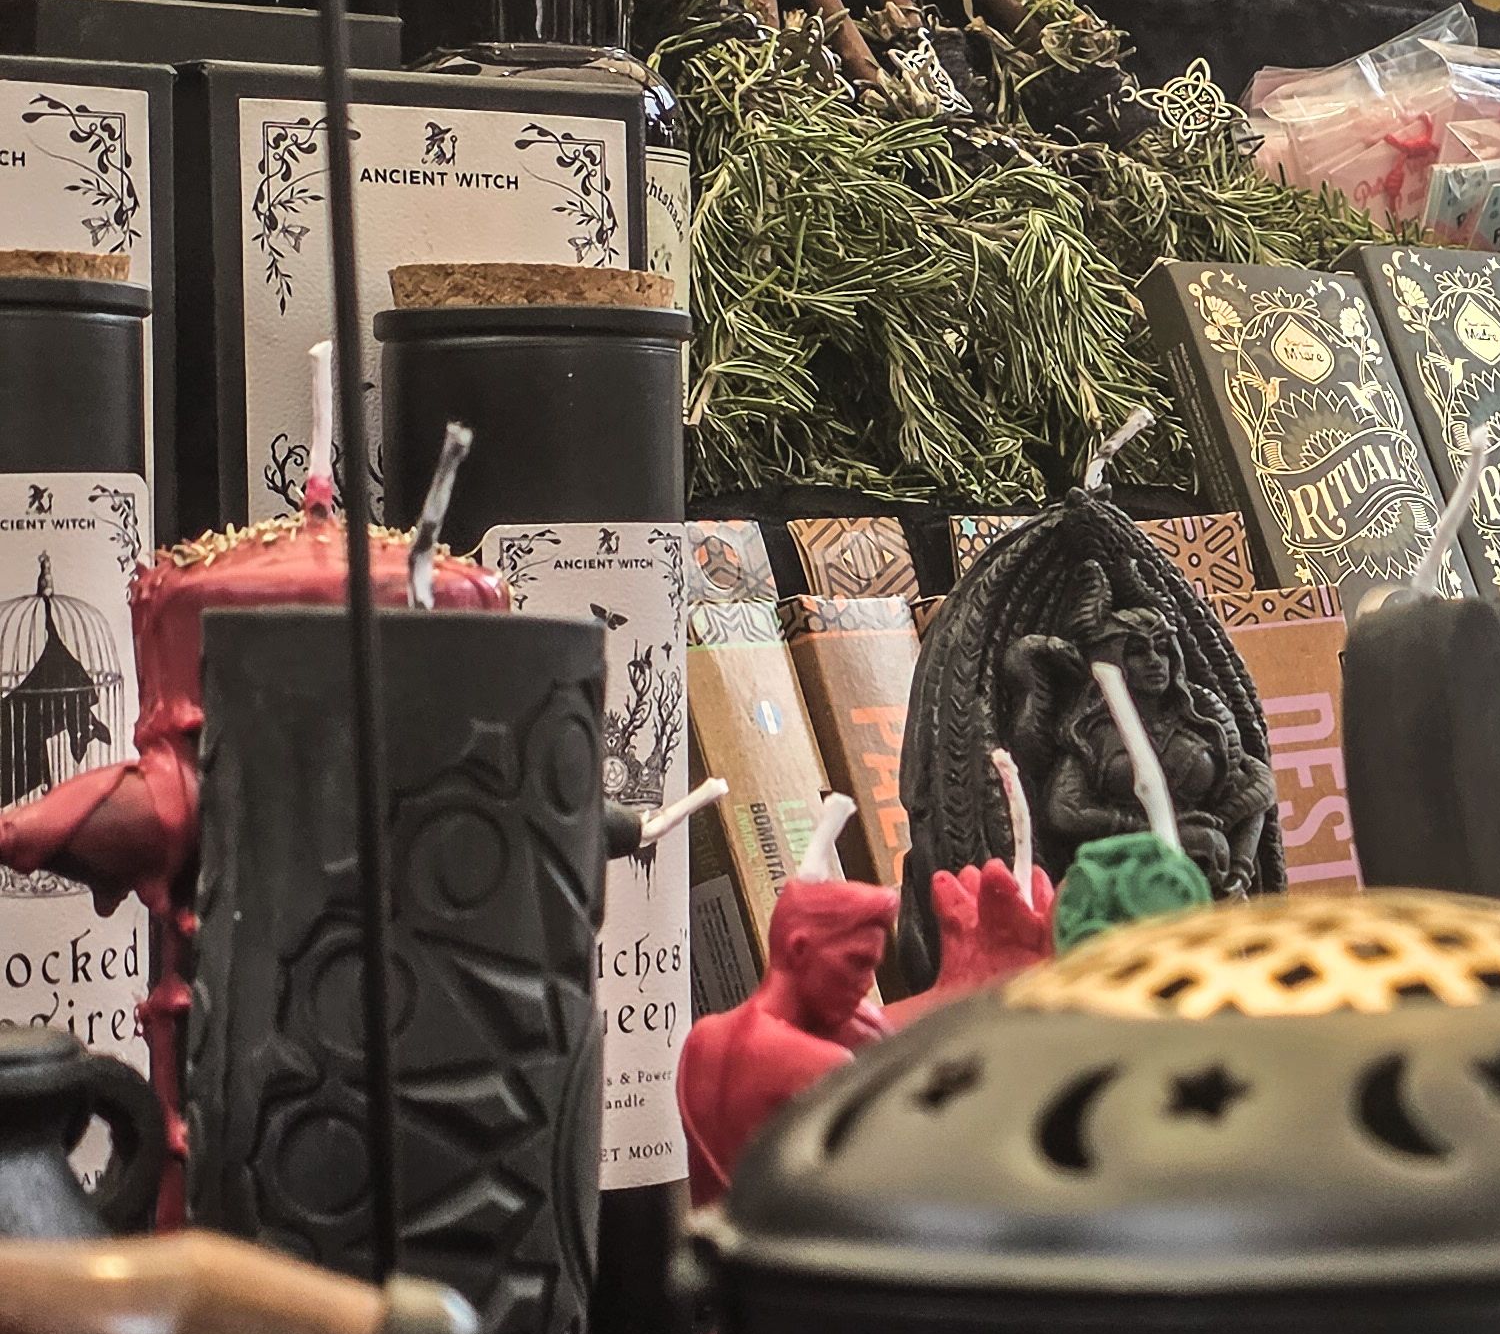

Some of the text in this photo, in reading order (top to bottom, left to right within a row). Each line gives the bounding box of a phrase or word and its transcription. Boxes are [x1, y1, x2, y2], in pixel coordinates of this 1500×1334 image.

[360, 167, 520, 191] ANCIENT WITCH
[1288, 443, 1408, 540] RITUAL
[0, 518, 96, 531] CIENT WITCH
[553, 558, 653, 570] ANCIENT WITCH
[850, 705, 909, 888] PAL
[750, 802, 787, 881] BOMBITA
[5, 926, 140, 988] ocked
[603, 1000, 677, 1048] een
[604, 1093, 646, 1110] andle
[628, 1141, 673, 1161] MOON
